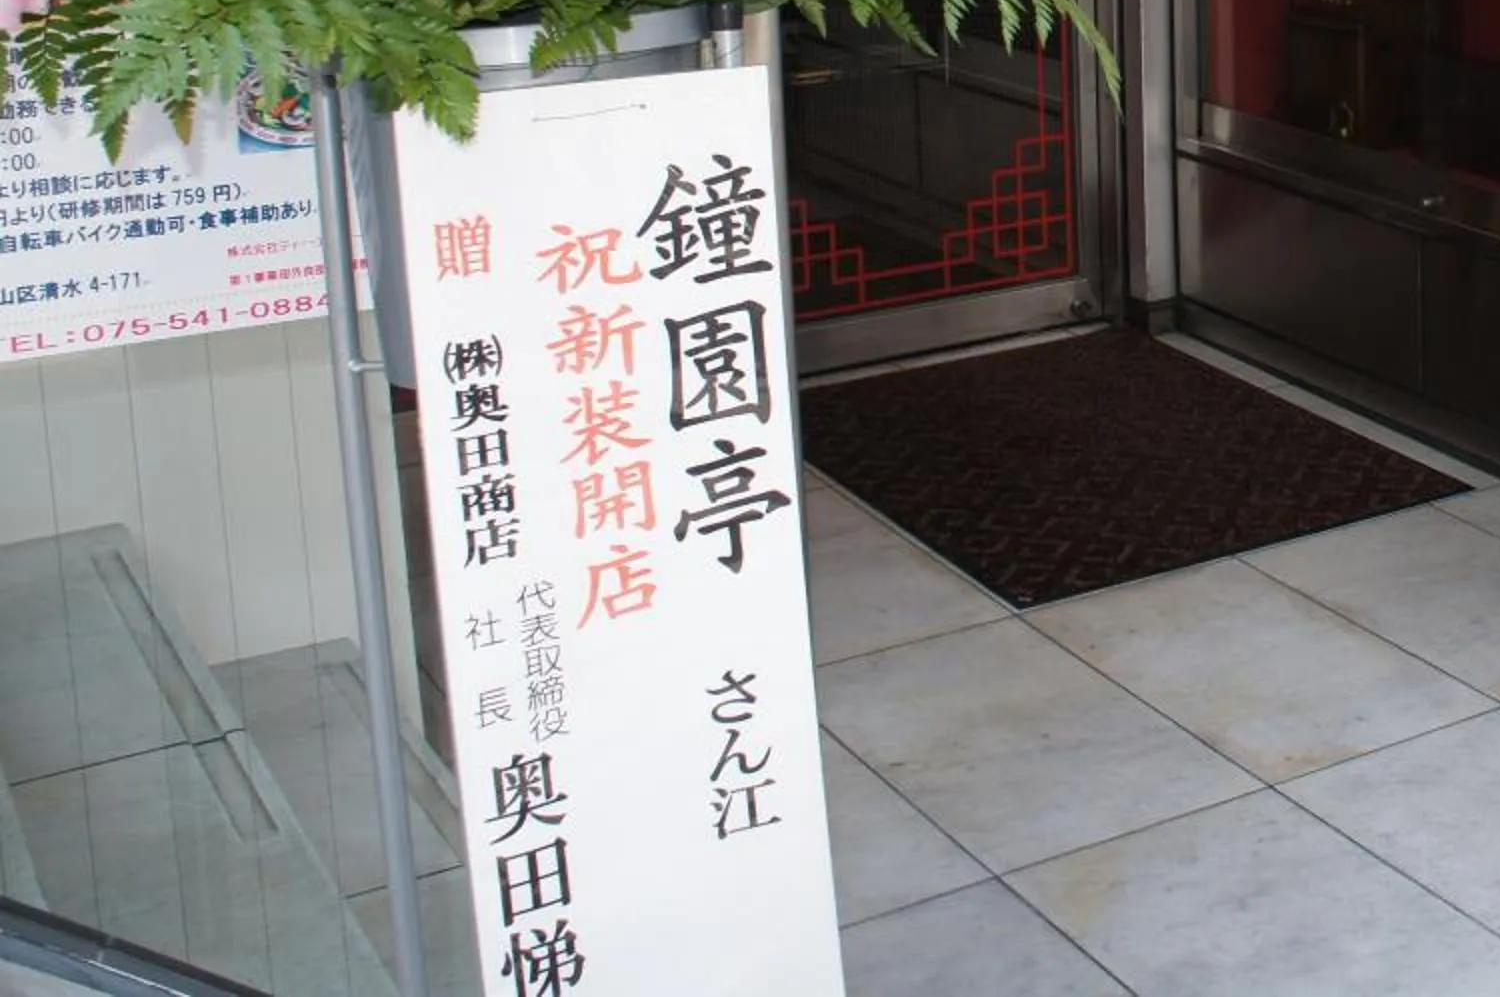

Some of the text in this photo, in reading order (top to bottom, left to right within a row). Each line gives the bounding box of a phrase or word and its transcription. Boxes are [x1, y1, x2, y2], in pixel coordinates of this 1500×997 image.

[433, 213, 492, 283] 贈
[535, 224, 659, 631] 祝新装開店
[637, 153, 792, 840] 鐘園亭 さん江
[516, 579, 570, 743] 代表取締役
